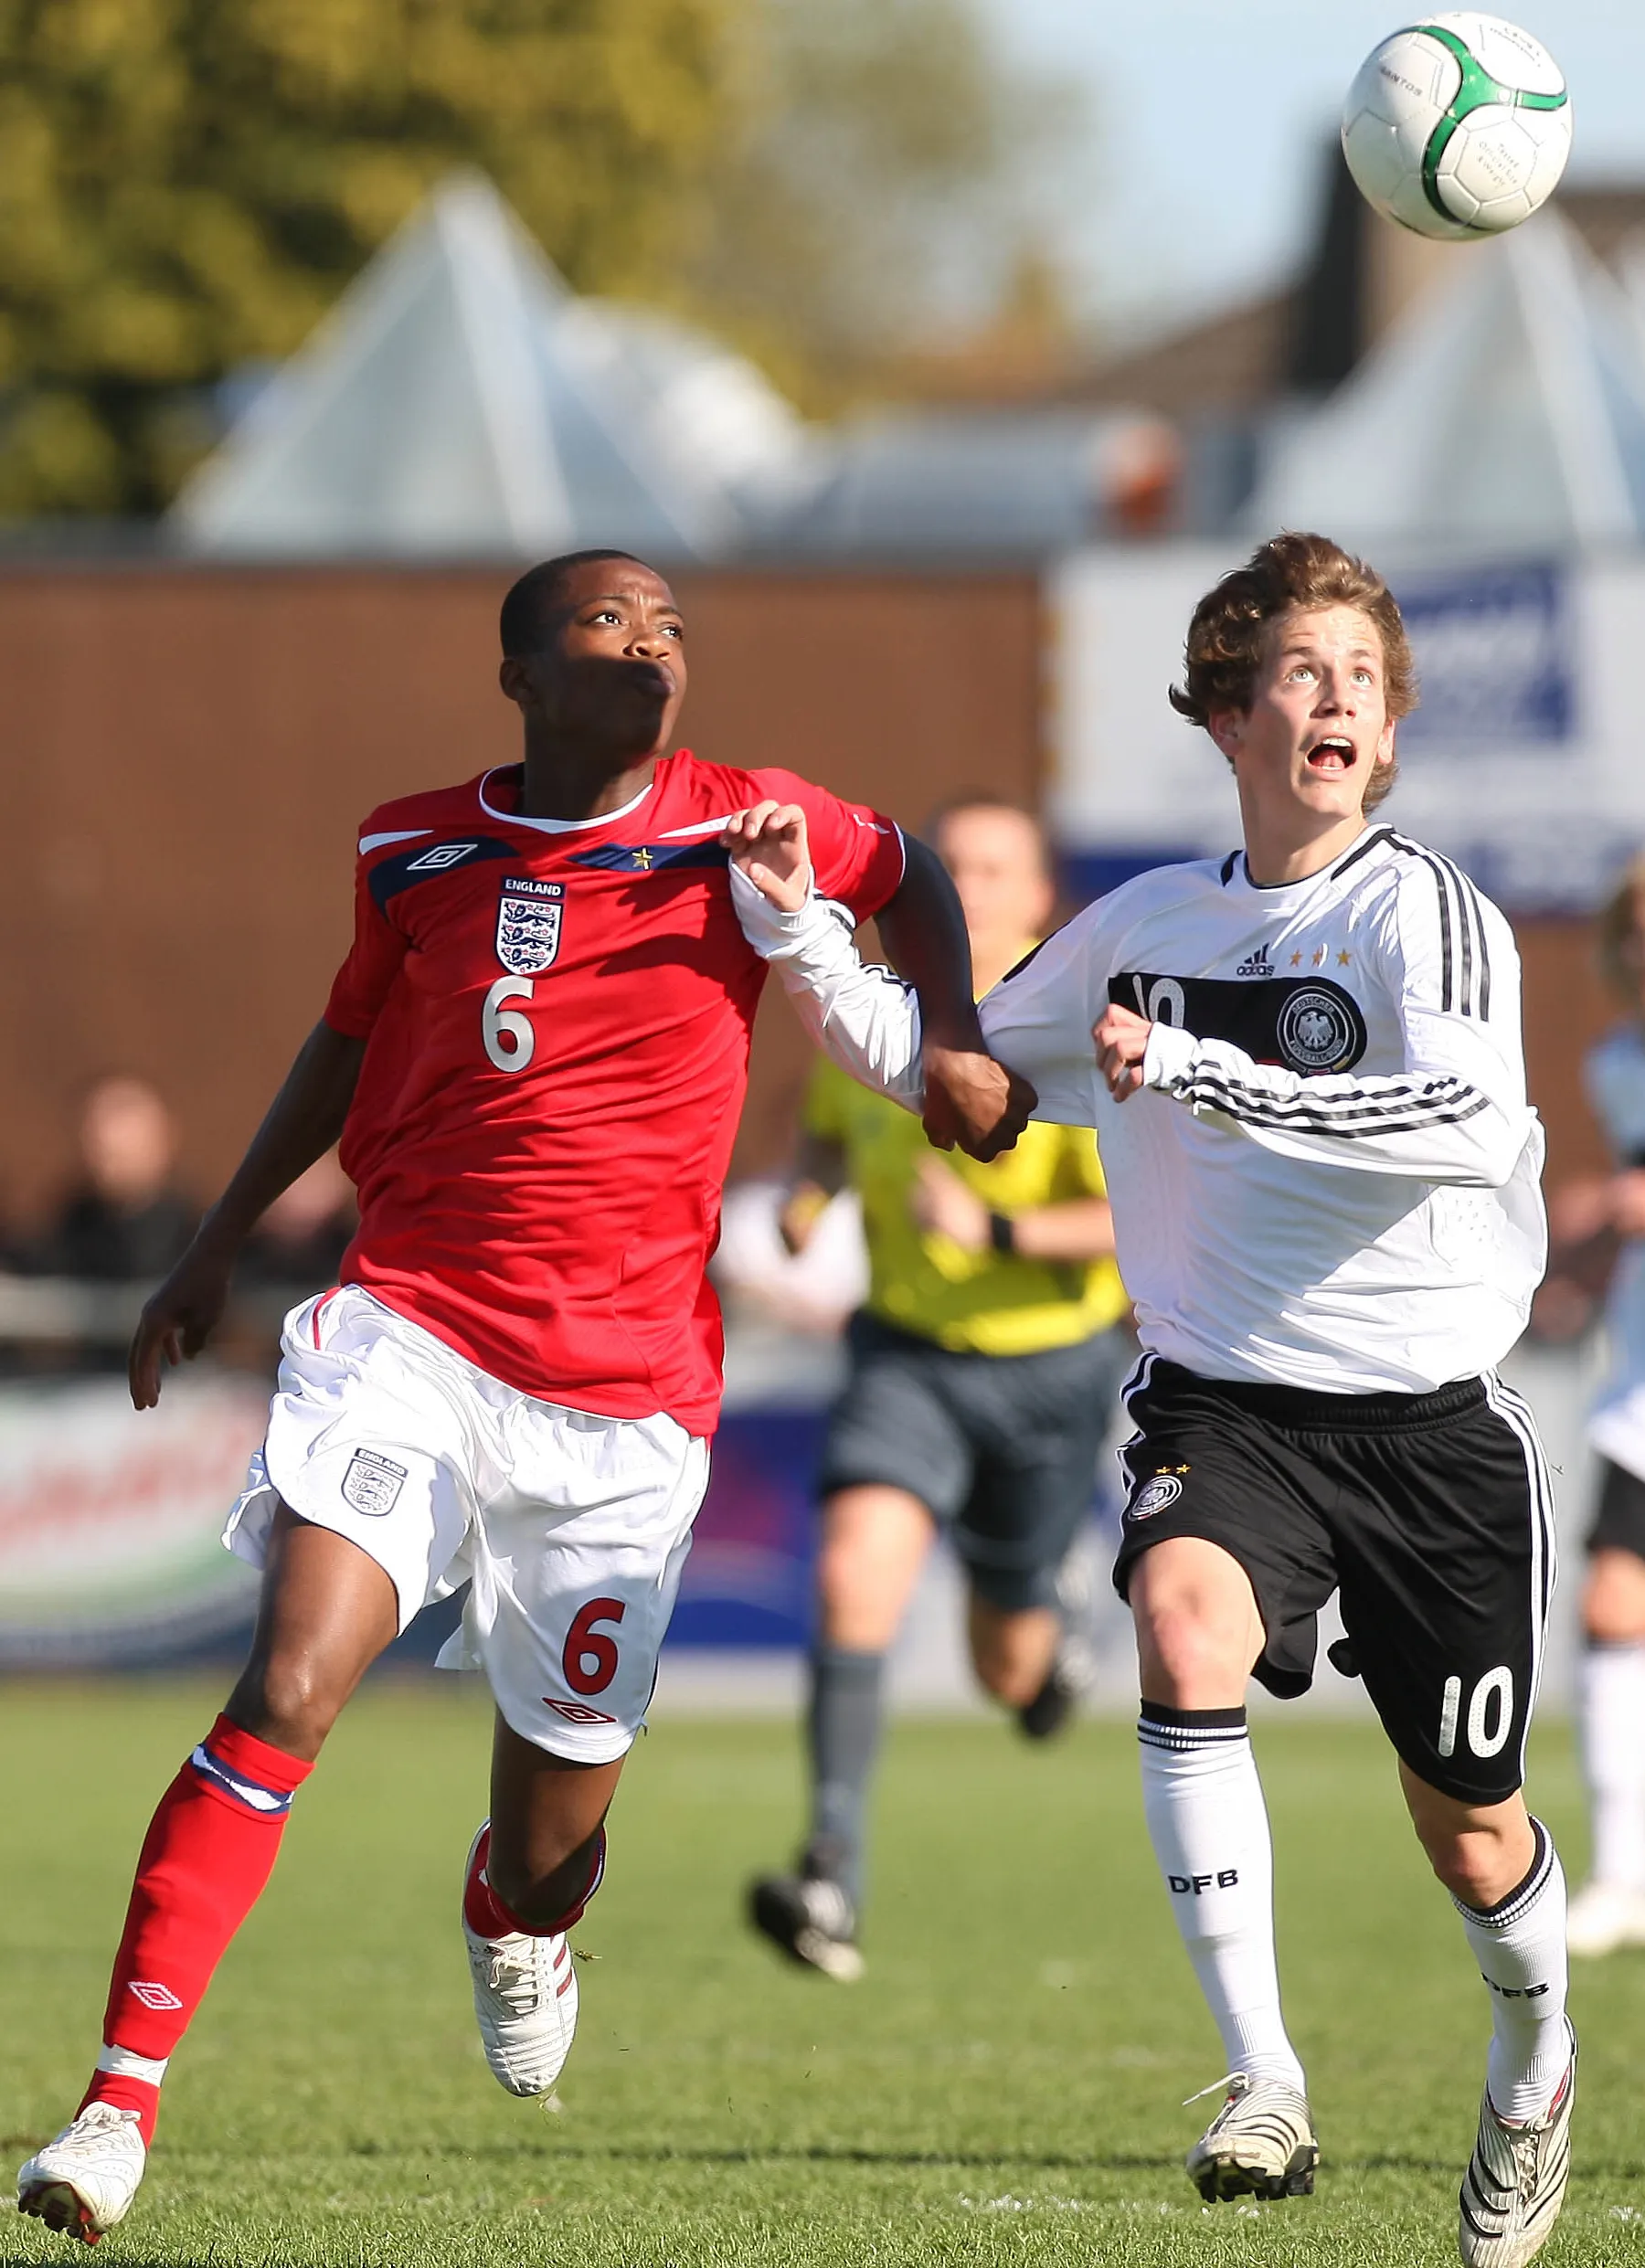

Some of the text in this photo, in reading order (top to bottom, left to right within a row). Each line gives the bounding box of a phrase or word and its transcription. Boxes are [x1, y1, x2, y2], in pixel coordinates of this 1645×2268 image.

[505, 878, 561, 896] ENGLAND
[1236, 964, 1275, 976] adidas
[482, 974, 536, 1073] 6
[562, 1596, 626, 1696] 6
[1438, 1665, 1514, 1758] 10
[1168, 1869, 1238, 1895] DFB
